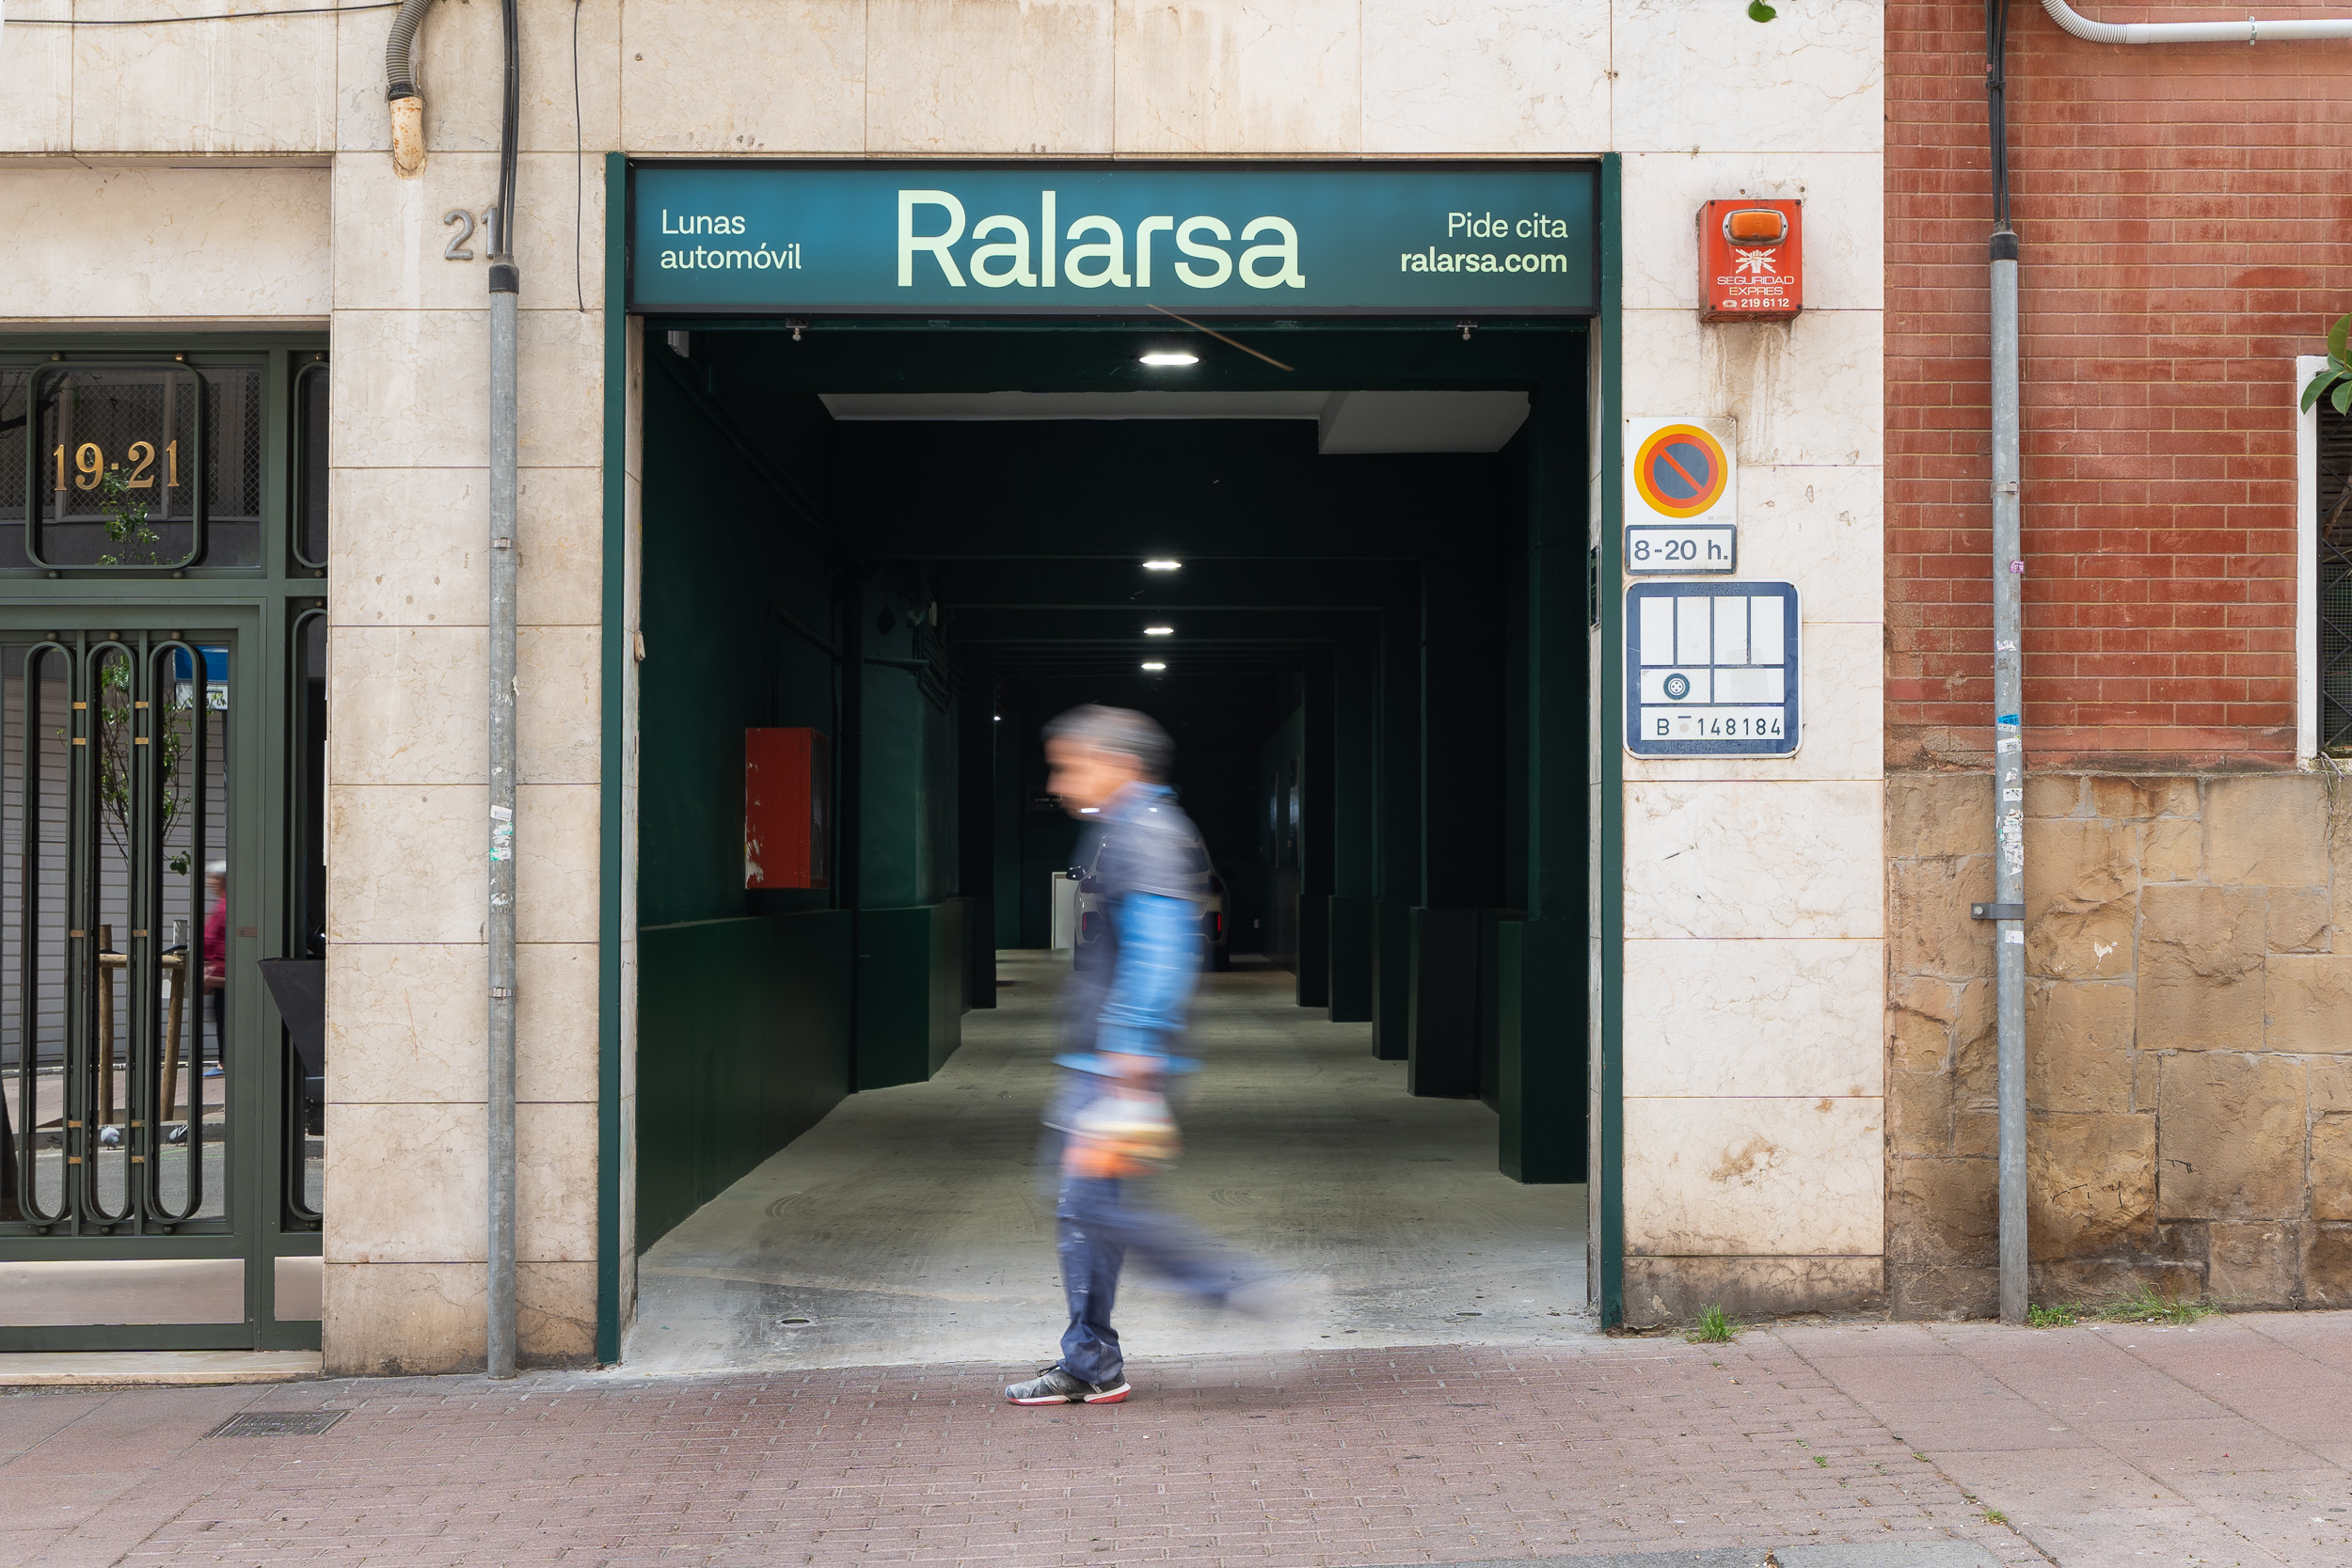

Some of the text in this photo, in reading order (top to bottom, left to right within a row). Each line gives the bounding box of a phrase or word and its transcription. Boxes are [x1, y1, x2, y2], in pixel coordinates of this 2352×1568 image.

[444, 207, 497, 261] 21
[662, 209, 746, 235] Lunas
[1448, 212, 1568, 238] Pide cita
[898, 190, 1306, 289] Ralarsa
[660, 243, 802, 270] automóvil
[1401, 245, 1567, 273] ralarsa.com
[1717, 277, 1794, 285] SEGURIDAD
[1729, 287, 1784, 295] EXPRES
[1740, 297, 1789, 308] 219 61 12
[1634, 539, 1728, 561] 8-20 h.
